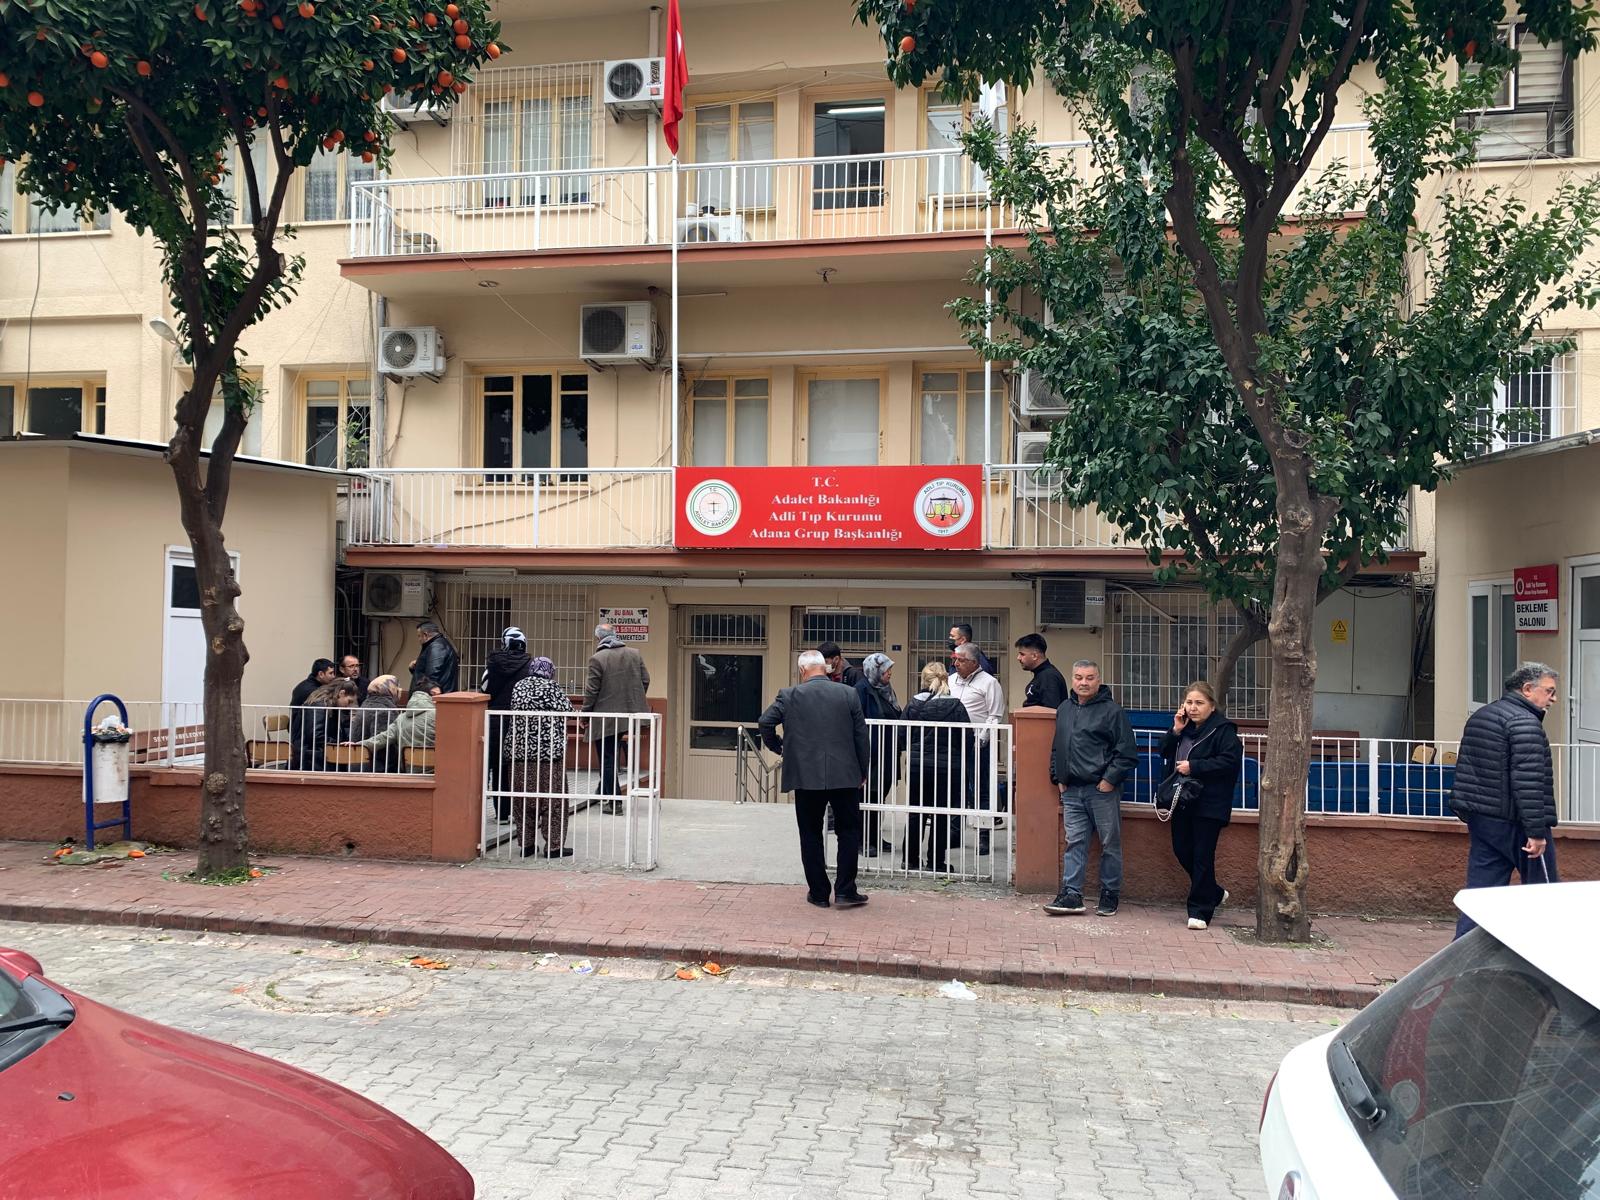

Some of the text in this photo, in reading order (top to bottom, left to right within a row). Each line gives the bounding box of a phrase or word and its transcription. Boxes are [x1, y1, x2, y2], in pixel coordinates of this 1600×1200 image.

[811, 476, 839, 488] T.C.
[771, 493, 880, 507] Adalet Bakanlığı
[768, 511, 882, 524] Adli Tıp Kurumu
[749, 527, 903, 542] Adana Grup Başkanlığı
[1516, 602, 1549, 614] BEKLEME
[1519, 617, 1546, 627] SALONU
